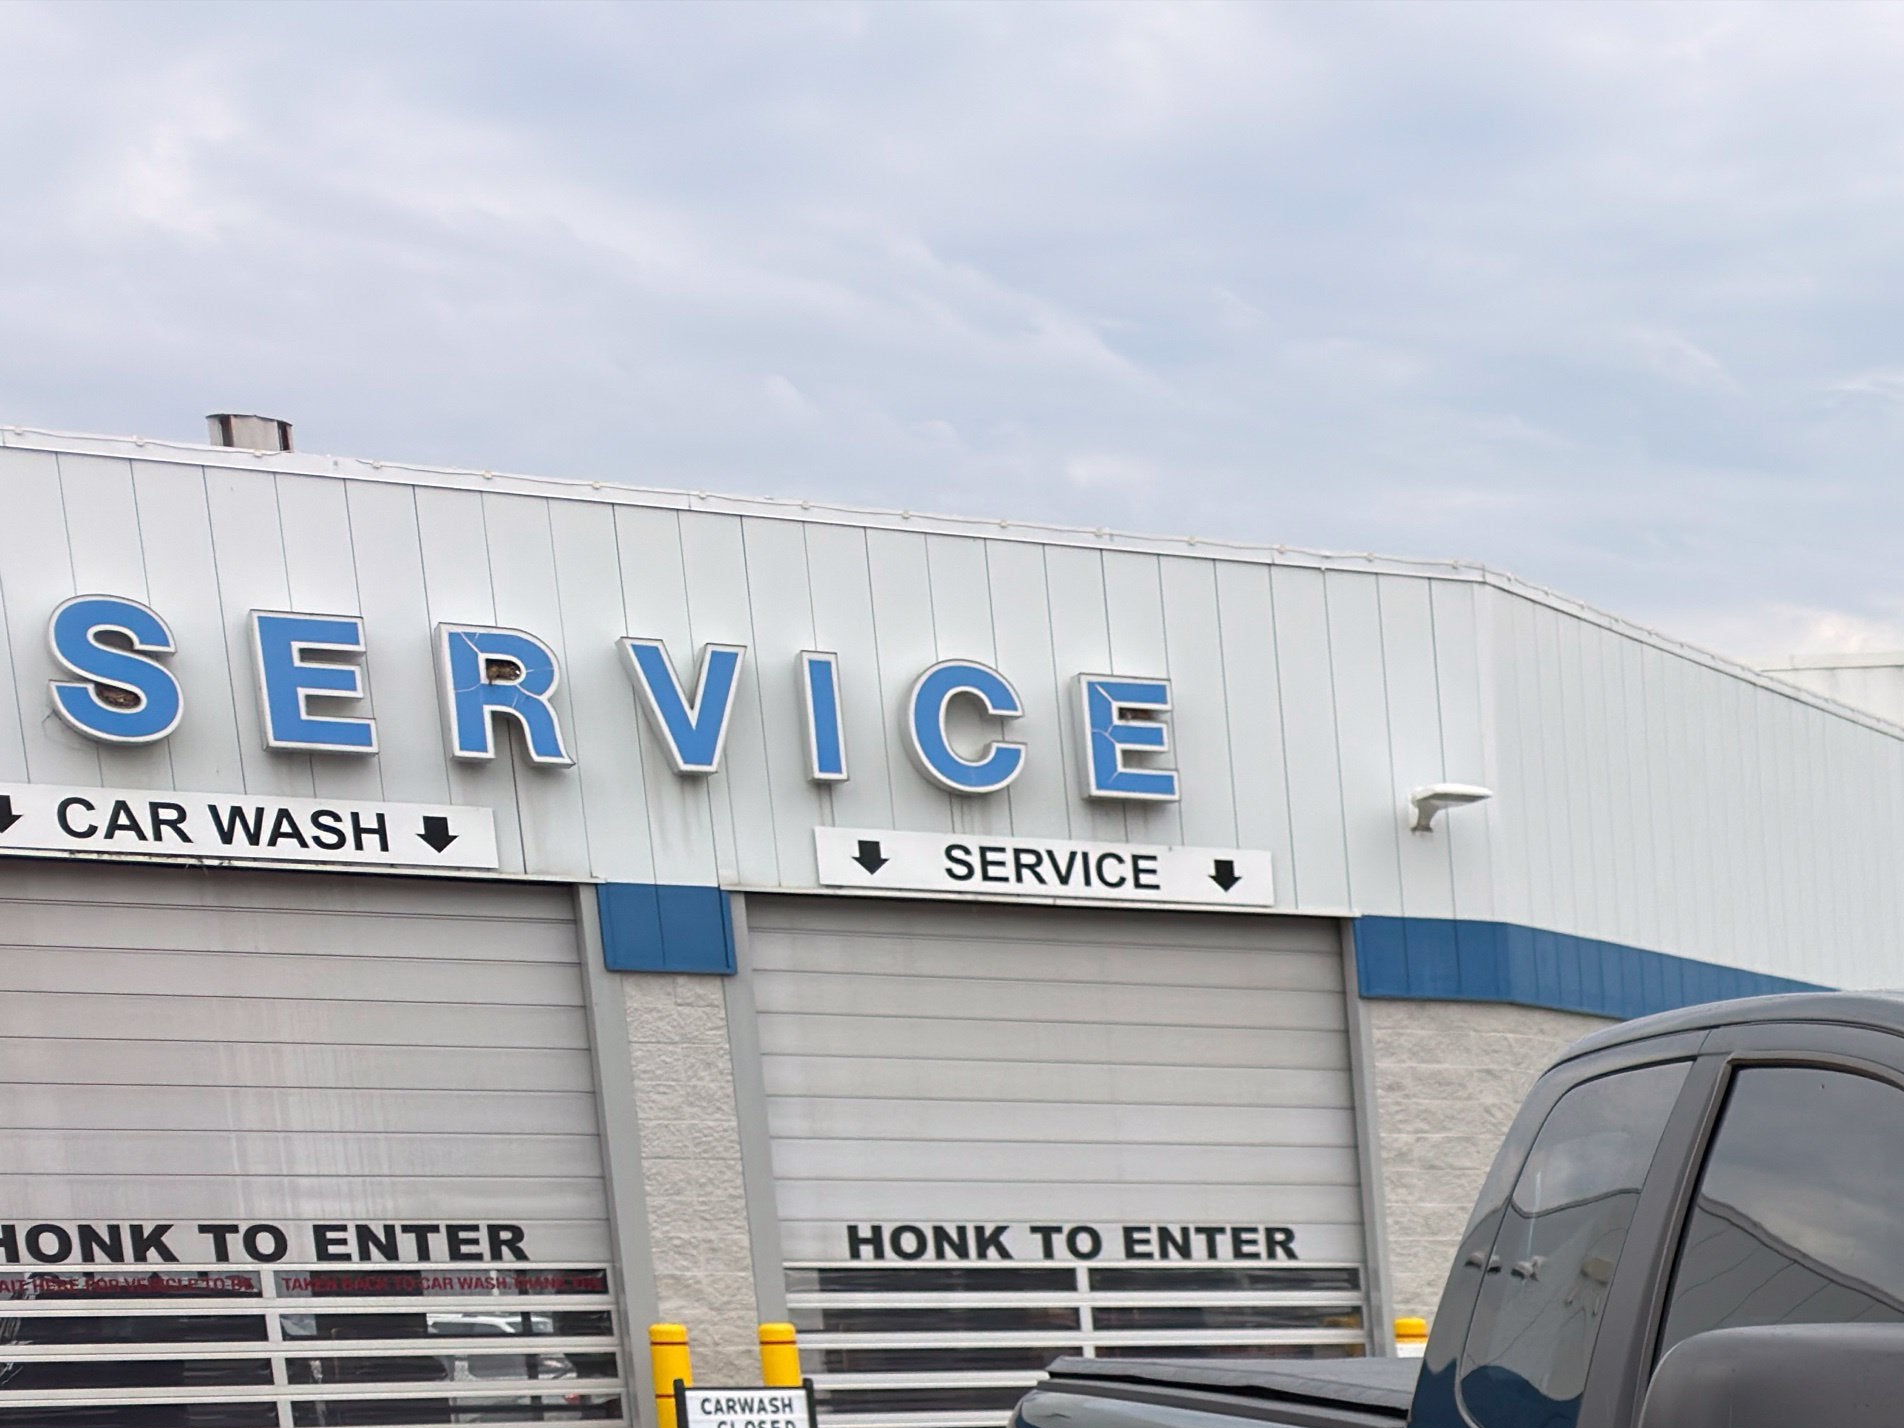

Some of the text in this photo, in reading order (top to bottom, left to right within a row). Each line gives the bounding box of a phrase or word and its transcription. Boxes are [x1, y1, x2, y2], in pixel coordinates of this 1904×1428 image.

[47, 593, 1181, 801] SERVICE
[56, 796, 390, 853] CAR WASH
[944, 844, 1161, 892] SERVICE
[198, 1224, 288, 1263] TO
[312, 1224, 530, 1262] ENTER
[846, 1225, 1298, 1261] HONK TO ENTER
[420, 1277, 454, 1290] CAR
[700, 1397, 794, 1416] CARWASH
